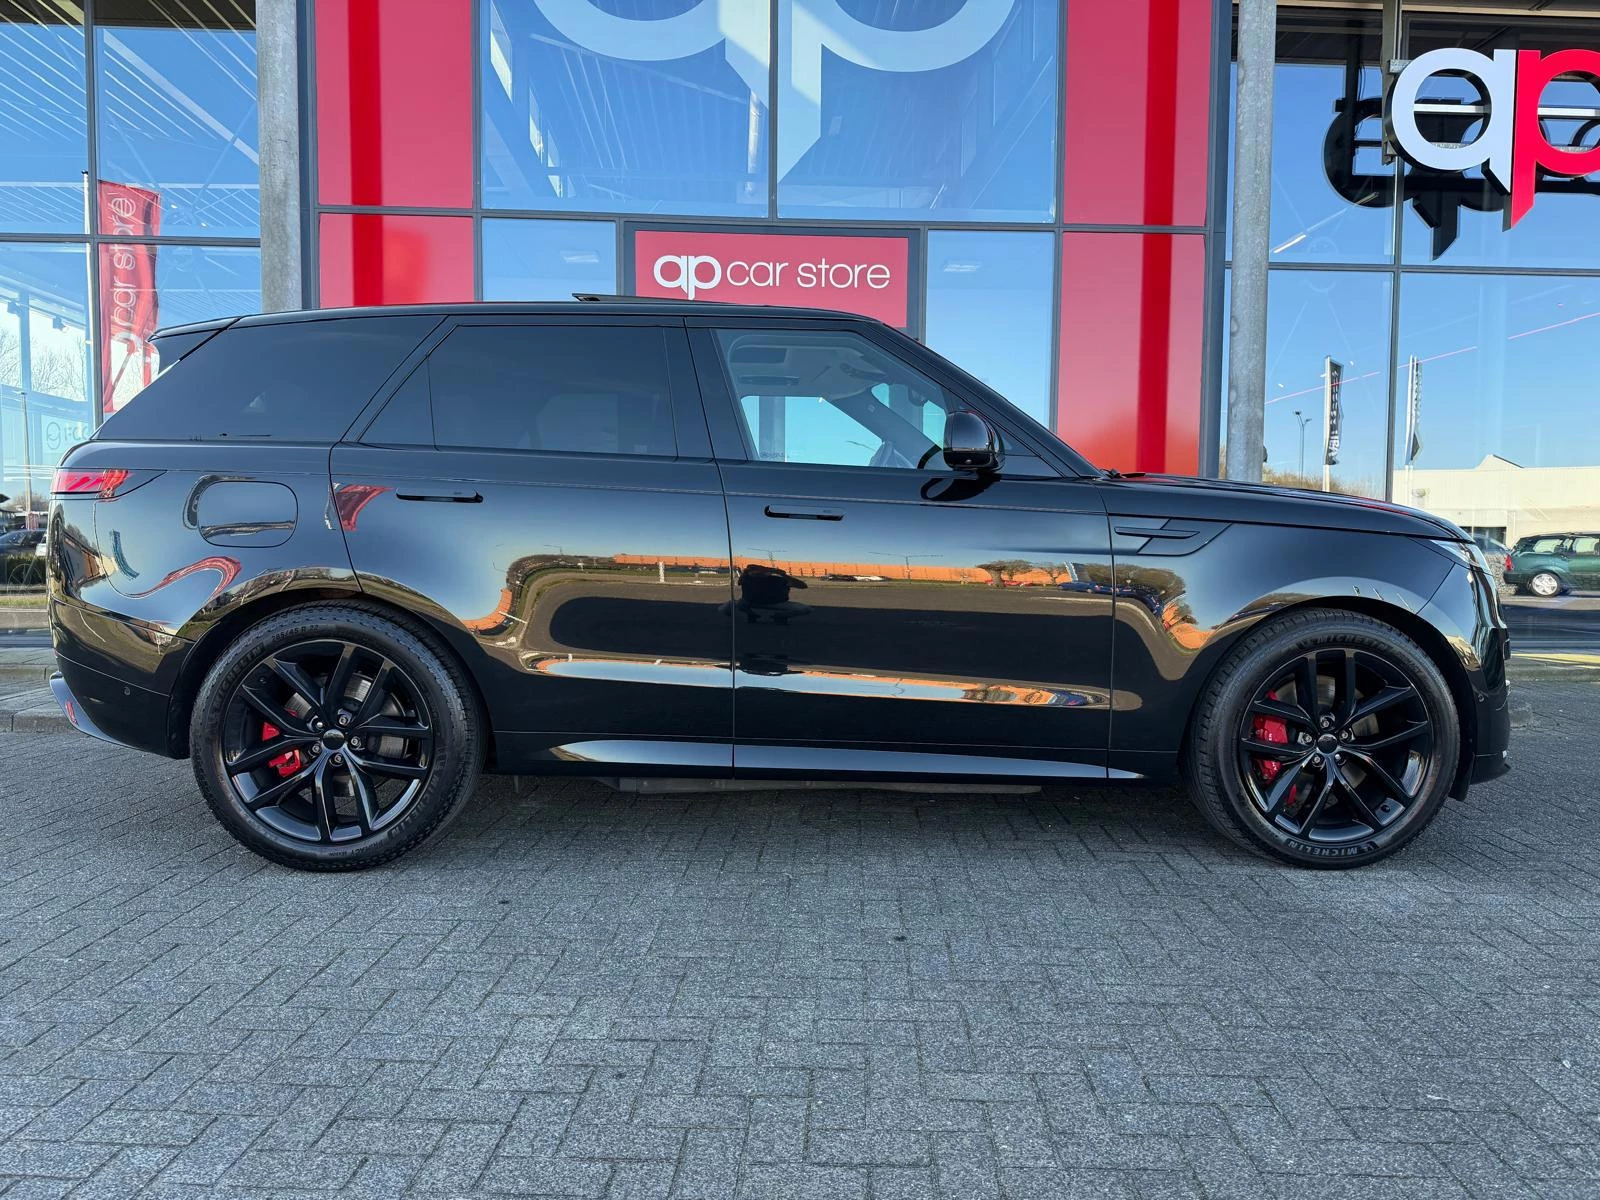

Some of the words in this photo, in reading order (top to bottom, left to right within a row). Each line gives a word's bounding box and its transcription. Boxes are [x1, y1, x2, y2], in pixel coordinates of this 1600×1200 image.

[1391, 47, 1600, 230] ap
[653, 254, 722, 300] ap
[726, 261, 789, 287] car
[796, 258, 891, 289] store
[1288, 840, 1359, 856] MICHELIN
